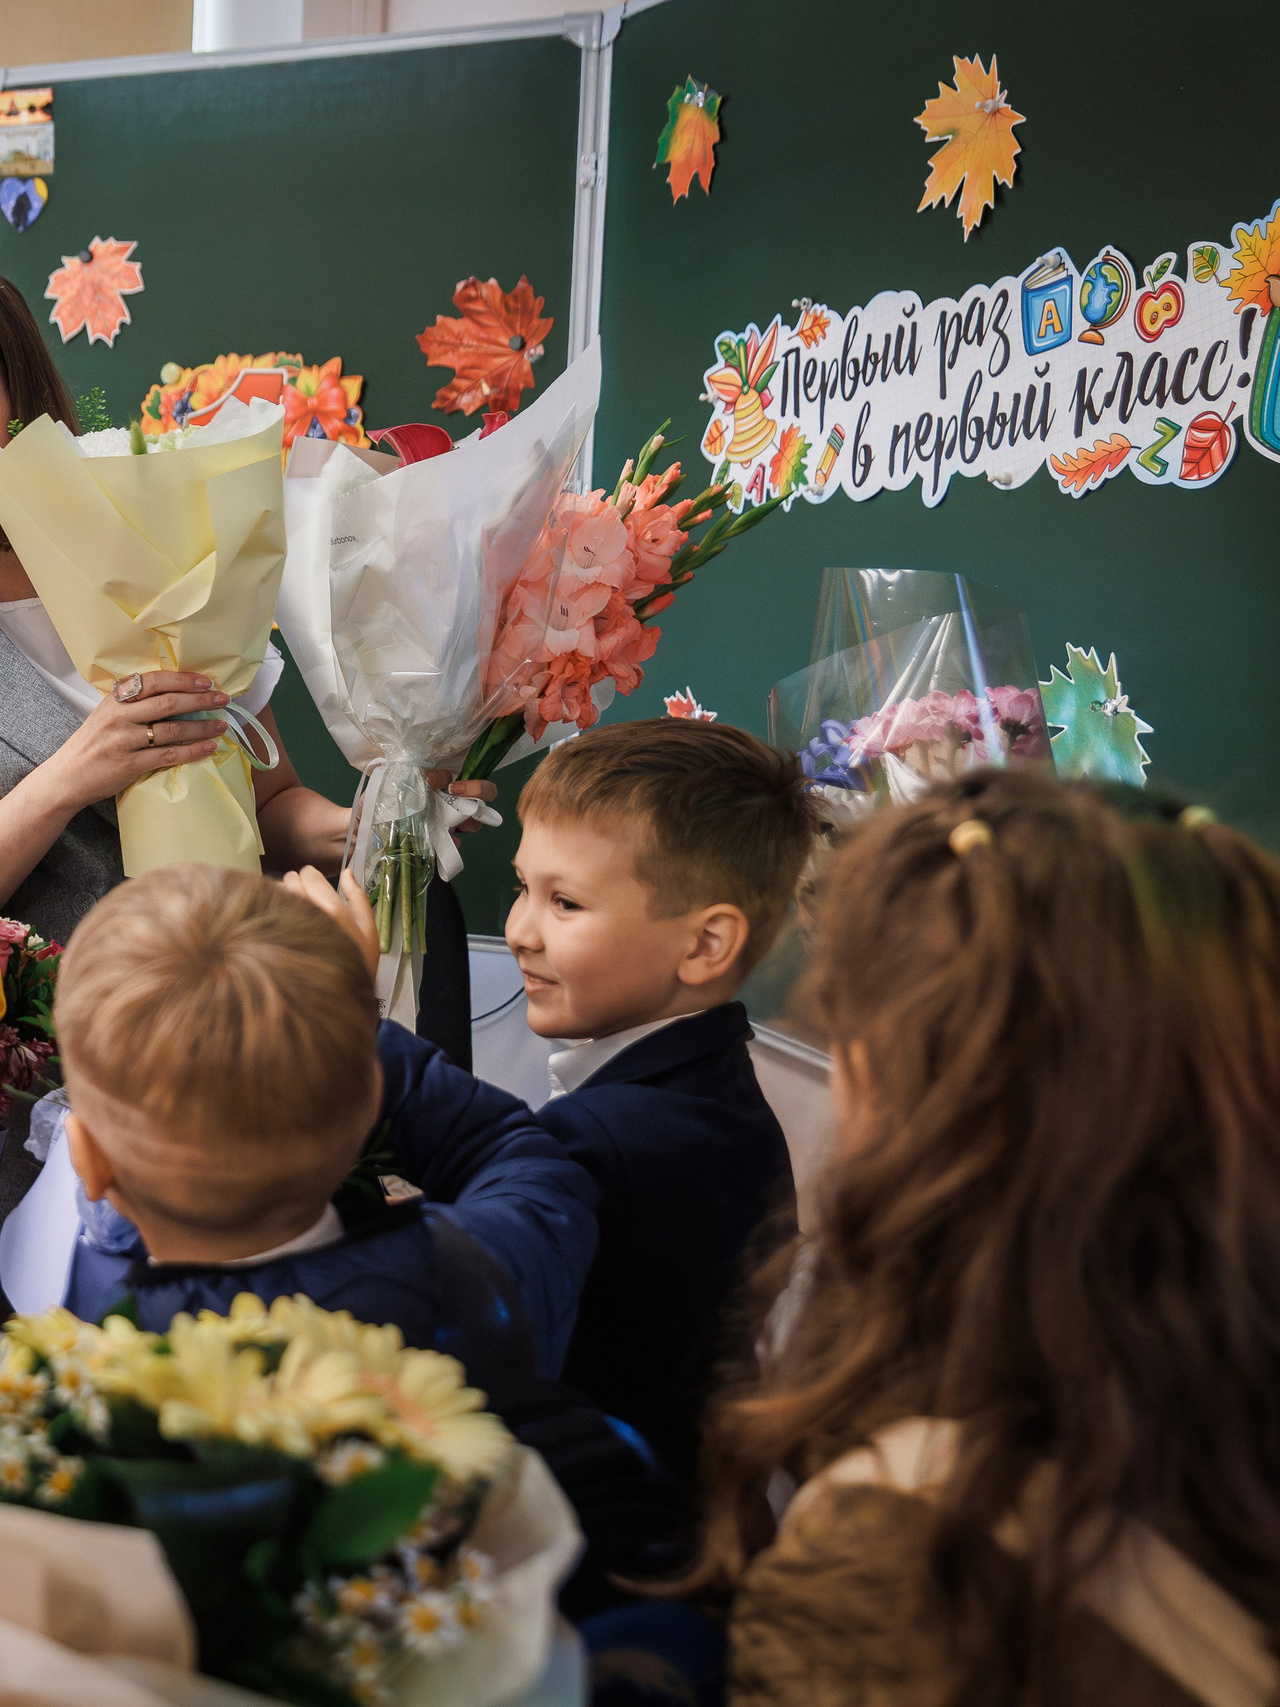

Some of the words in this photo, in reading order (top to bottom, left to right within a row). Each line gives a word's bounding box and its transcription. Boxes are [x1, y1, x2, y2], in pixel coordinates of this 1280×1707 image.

[780, 303, 923, 434] Первый
[933, 289, 1012, 400] раз
[851, 401, 876, 488] в
[888, 362, 1057, 497] первый
[1069, 307, 1258, 438] класс!
[1136, 416, 1183, 478] Z
